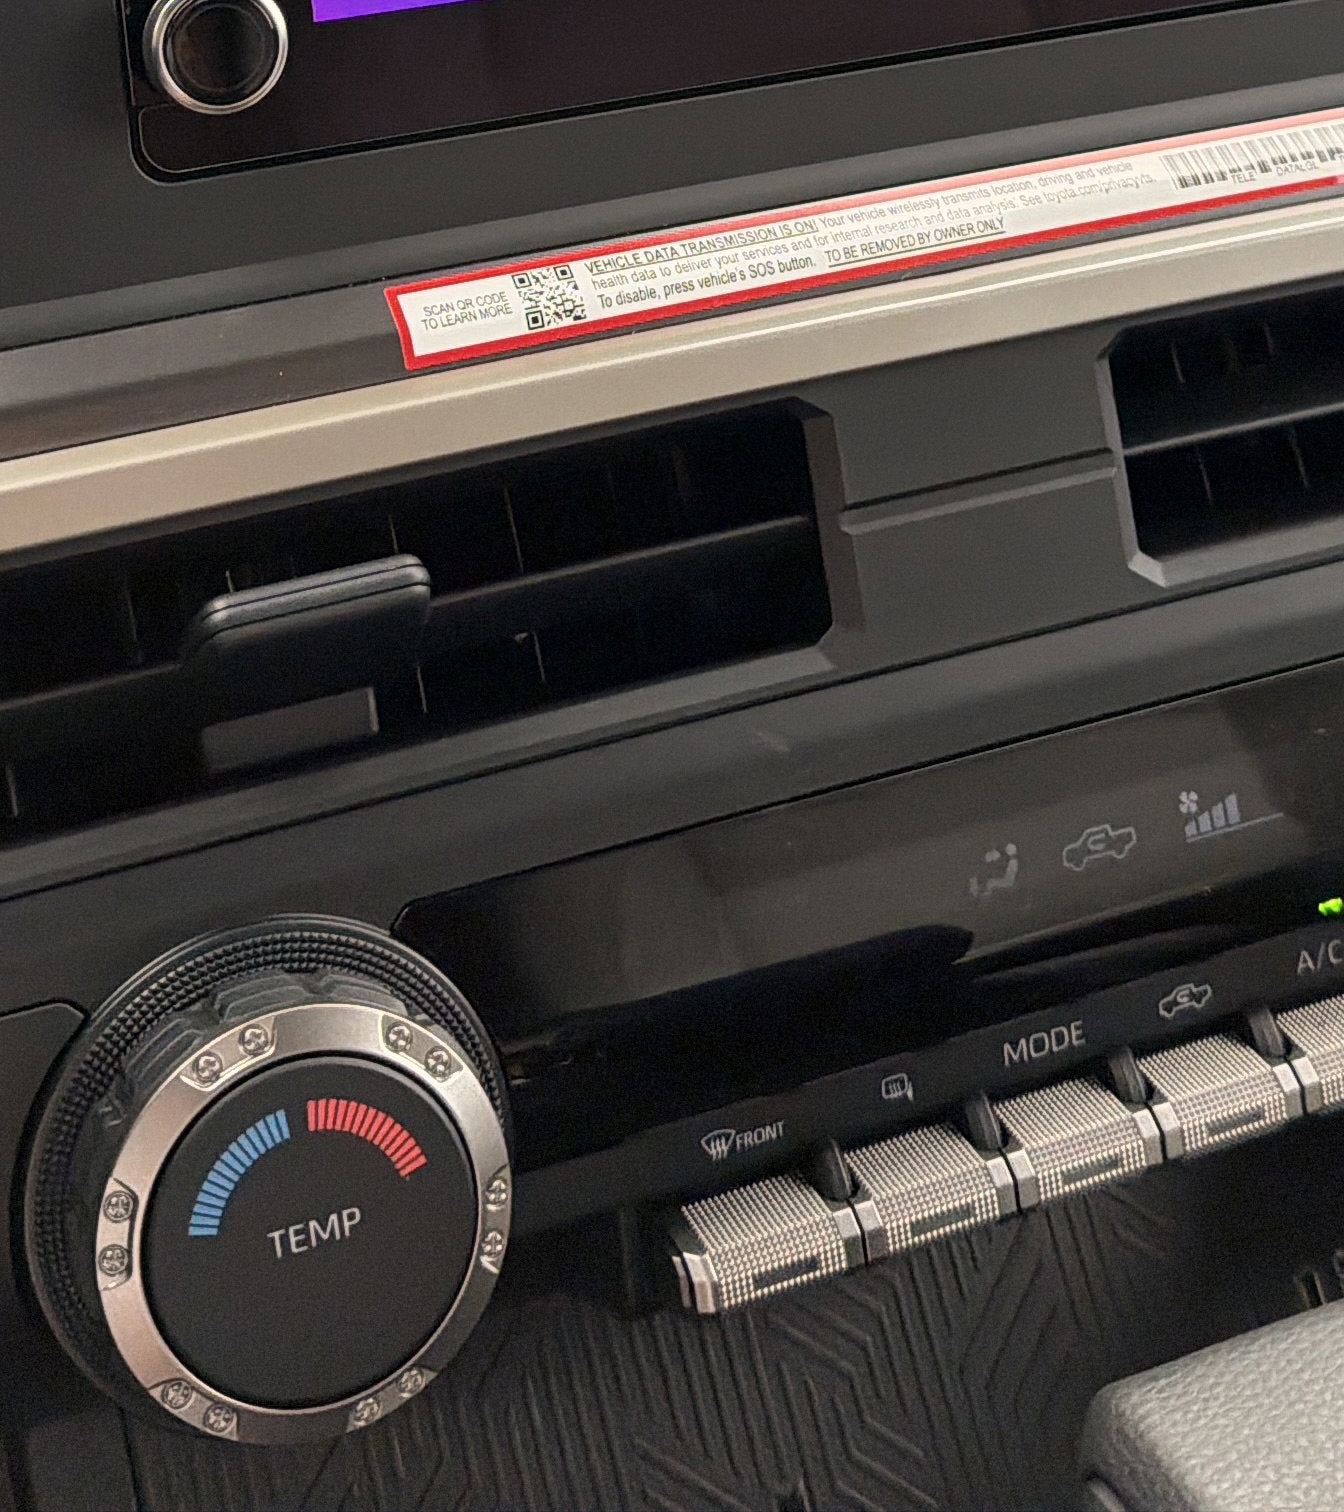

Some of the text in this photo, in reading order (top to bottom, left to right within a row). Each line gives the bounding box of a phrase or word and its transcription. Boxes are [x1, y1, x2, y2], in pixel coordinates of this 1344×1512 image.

[584, 252, 641, 274] VEHICLE
[644, 246, 680, 263] DATA
[680, 226, 777, 256] TRANSMISSION
[779, 223, 793, 237] IS
[794, 219, 818, 233] ON!
[819, 214, 845, 228] Your
[847, 206, 886, 222] vehicle
[887, 197, 940, 217] wirelessly
[941, 187, 991, 205] transmits
[1039, 172, 1074, 187] driving
[1075, 167, 1095, 180] and
[1096, 161, 1133, 177] vehicle
[590, 272, 629, 290] health
[631, 267, 657, 283] data
[659, 265, 672, 278] to
[675, 256, 712, 274] deliver
[716, 252, 739, 268] your
[742, 244, 789, 260] services
[791, 236, 813, 251] and
[813, 233, 830, 248] for
[830, 224, 873, 243] internal
[874, 215, 923, 235] research
[924, 211, 945, 225] and
[946, 207, 970, 220] data
[1020, 194, 1042, 207] See
[597, 216, 1005, 309] To disable, press vehicle's SOS button. TO BE REMOVED BY OWNER ONLY
[421, 302, 513, 331] TO LEARN MORE
[423, 291, 507, 316] SCAN QR CODE
[1296, 940, 1344, 975] A/C
[1002, 1020, 1087, 1068] MODE
[735, 1119, 787, 1149] FRONT
[266, 1206, 363, 1259] TEMP
